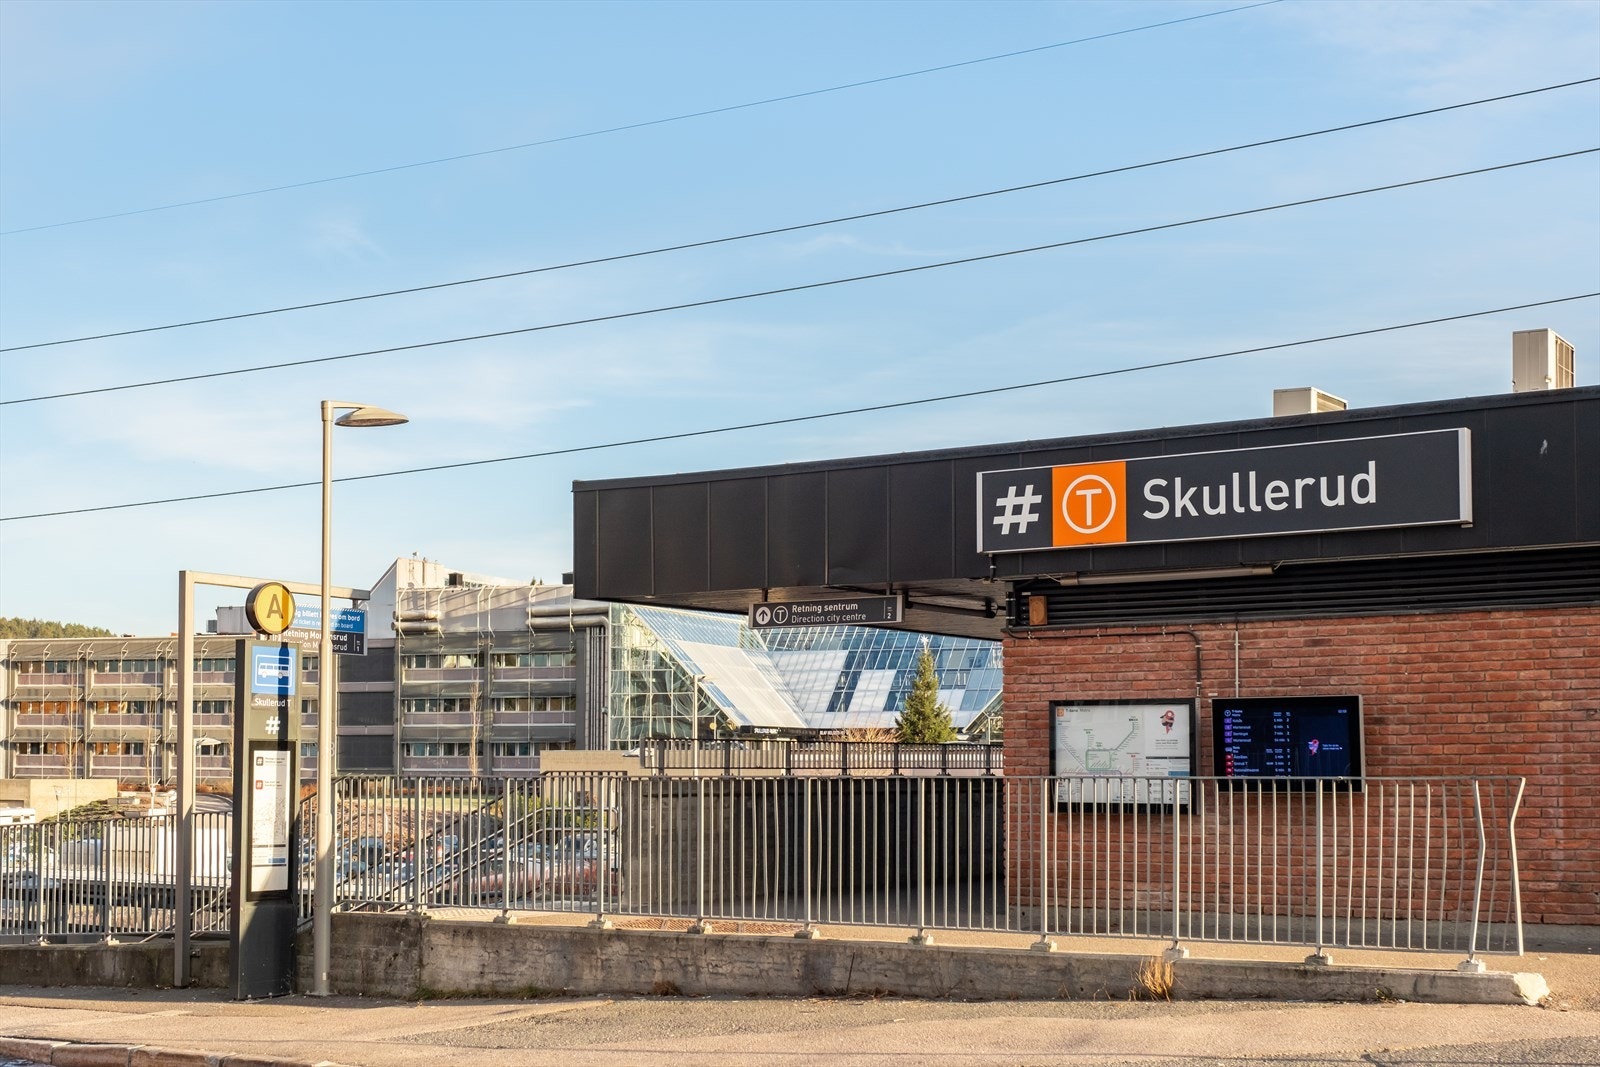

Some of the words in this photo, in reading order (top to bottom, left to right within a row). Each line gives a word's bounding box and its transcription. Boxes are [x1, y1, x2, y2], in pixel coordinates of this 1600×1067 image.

[1143, 460, 1376, 520] Skullerud
[266, 593, 284, 620] A
[792, 603, 822, 613] Retning
[824, 603, 858, 612] sentrum
[791, 614, 825, 623] Direction
[827, 613, 841, 623] city
[842, 613, 867, 621] centre
[254, 697, 286, 707] Skullerud
[287, 699, 292, 708] T
